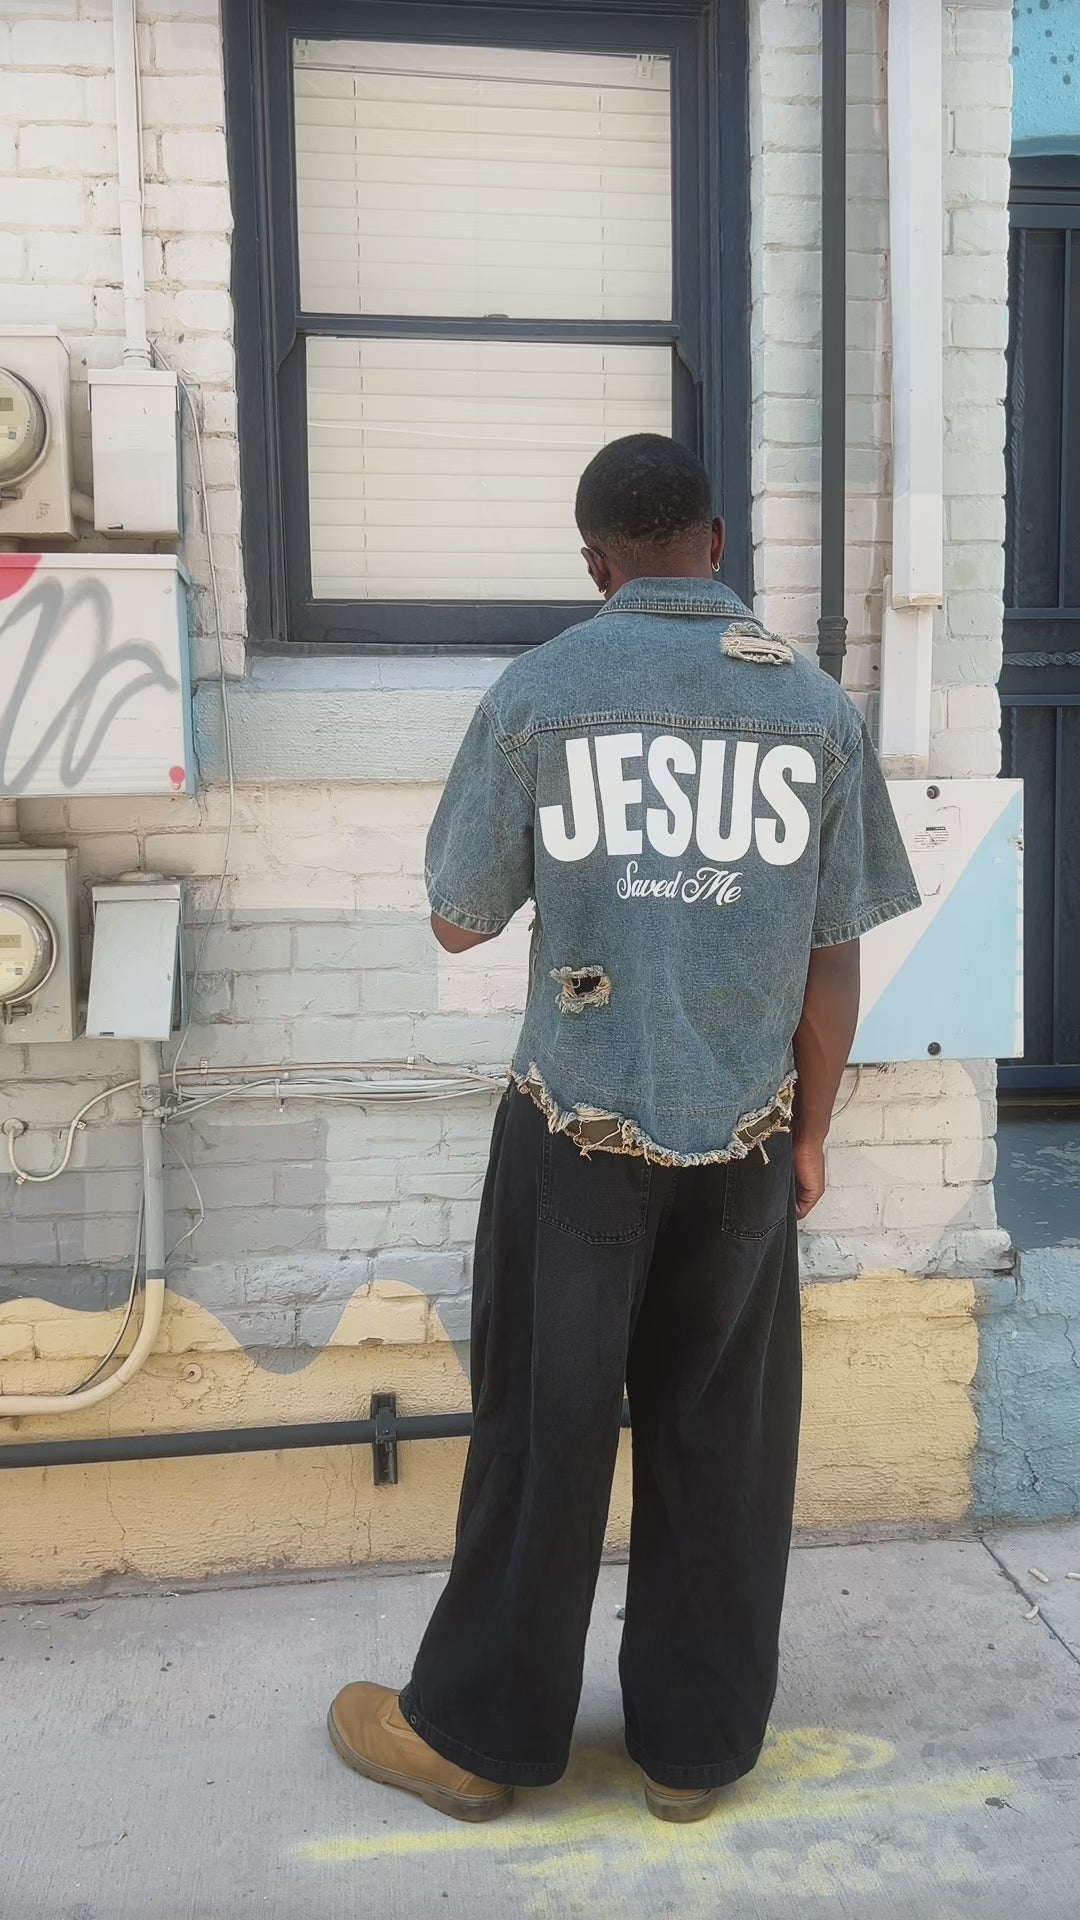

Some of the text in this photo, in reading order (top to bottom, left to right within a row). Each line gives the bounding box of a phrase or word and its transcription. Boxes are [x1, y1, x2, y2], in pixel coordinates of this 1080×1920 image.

[538, 732, 817, 866] JESUS
[616, 860, 743, 905] Saved Me
